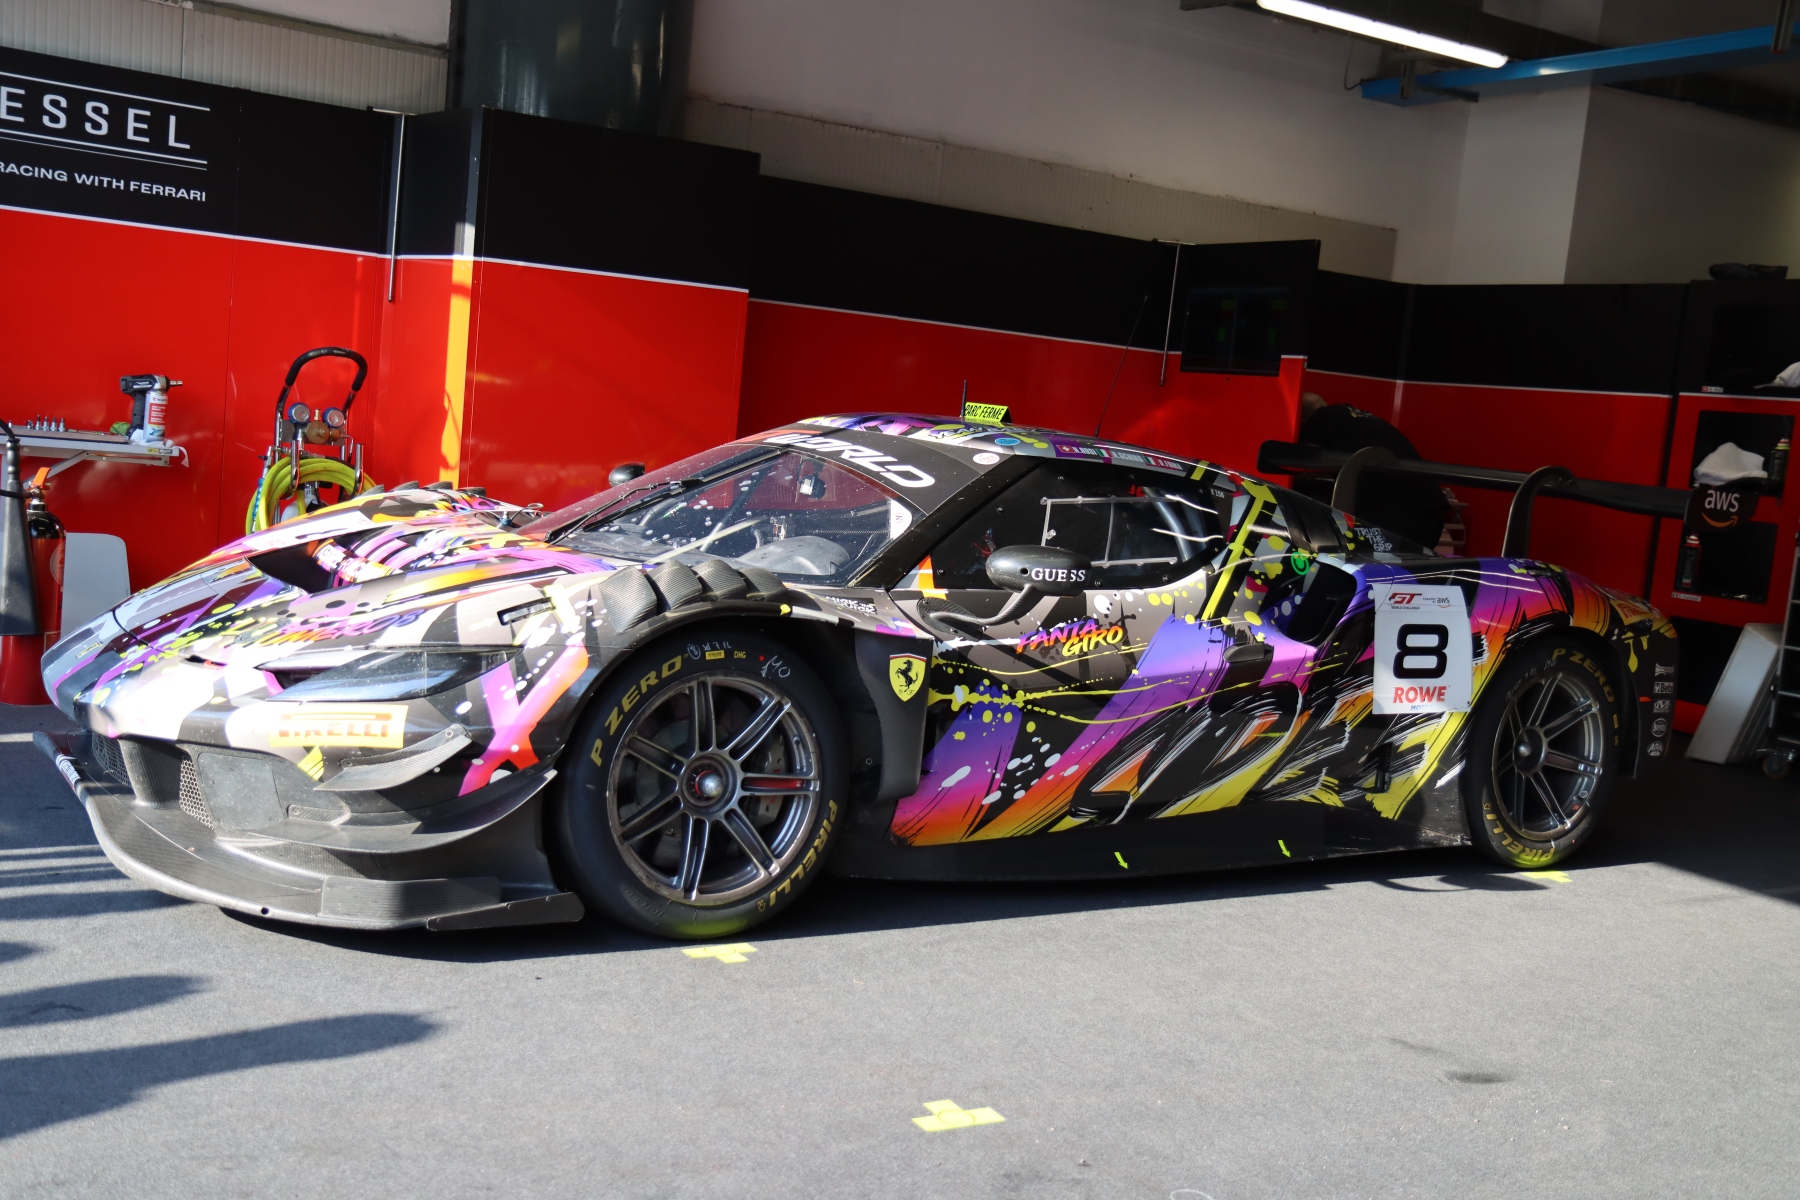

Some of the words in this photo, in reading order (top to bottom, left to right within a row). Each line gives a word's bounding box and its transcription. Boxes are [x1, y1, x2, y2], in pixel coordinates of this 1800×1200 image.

[74, 172, 125, 190] WITH
[129, 181, 206, 202] FERRARI
[979, 406, 1005, 419] FERME
[763, 433, 936, 488] WORLD
[1705, 489, 1740, 513] aws
[1354, 527, 1382, 536] TRUST
[1366, 535, 1386, 545] THE
[1373, 542, 1393, 552] GRIP
[1031, 567, 1086, 582] GUESS
[1016, 619, 1099, 655] FANTA
[1062, 625, 1124, 657] GIRO
[1393, 624, 1449, 679] 8
[1552, 648, 1566, 660] P
[1568, 651, 1615, 703] ZERO
[1392, 685, 1447, 703] ROWE
[590, 738, 603, 767] P
[604, 655, 683, 736] ZERO
[769, 799, 839, 906] PIRELLI
[1485, 812, 1556, 862] PIRELLI
